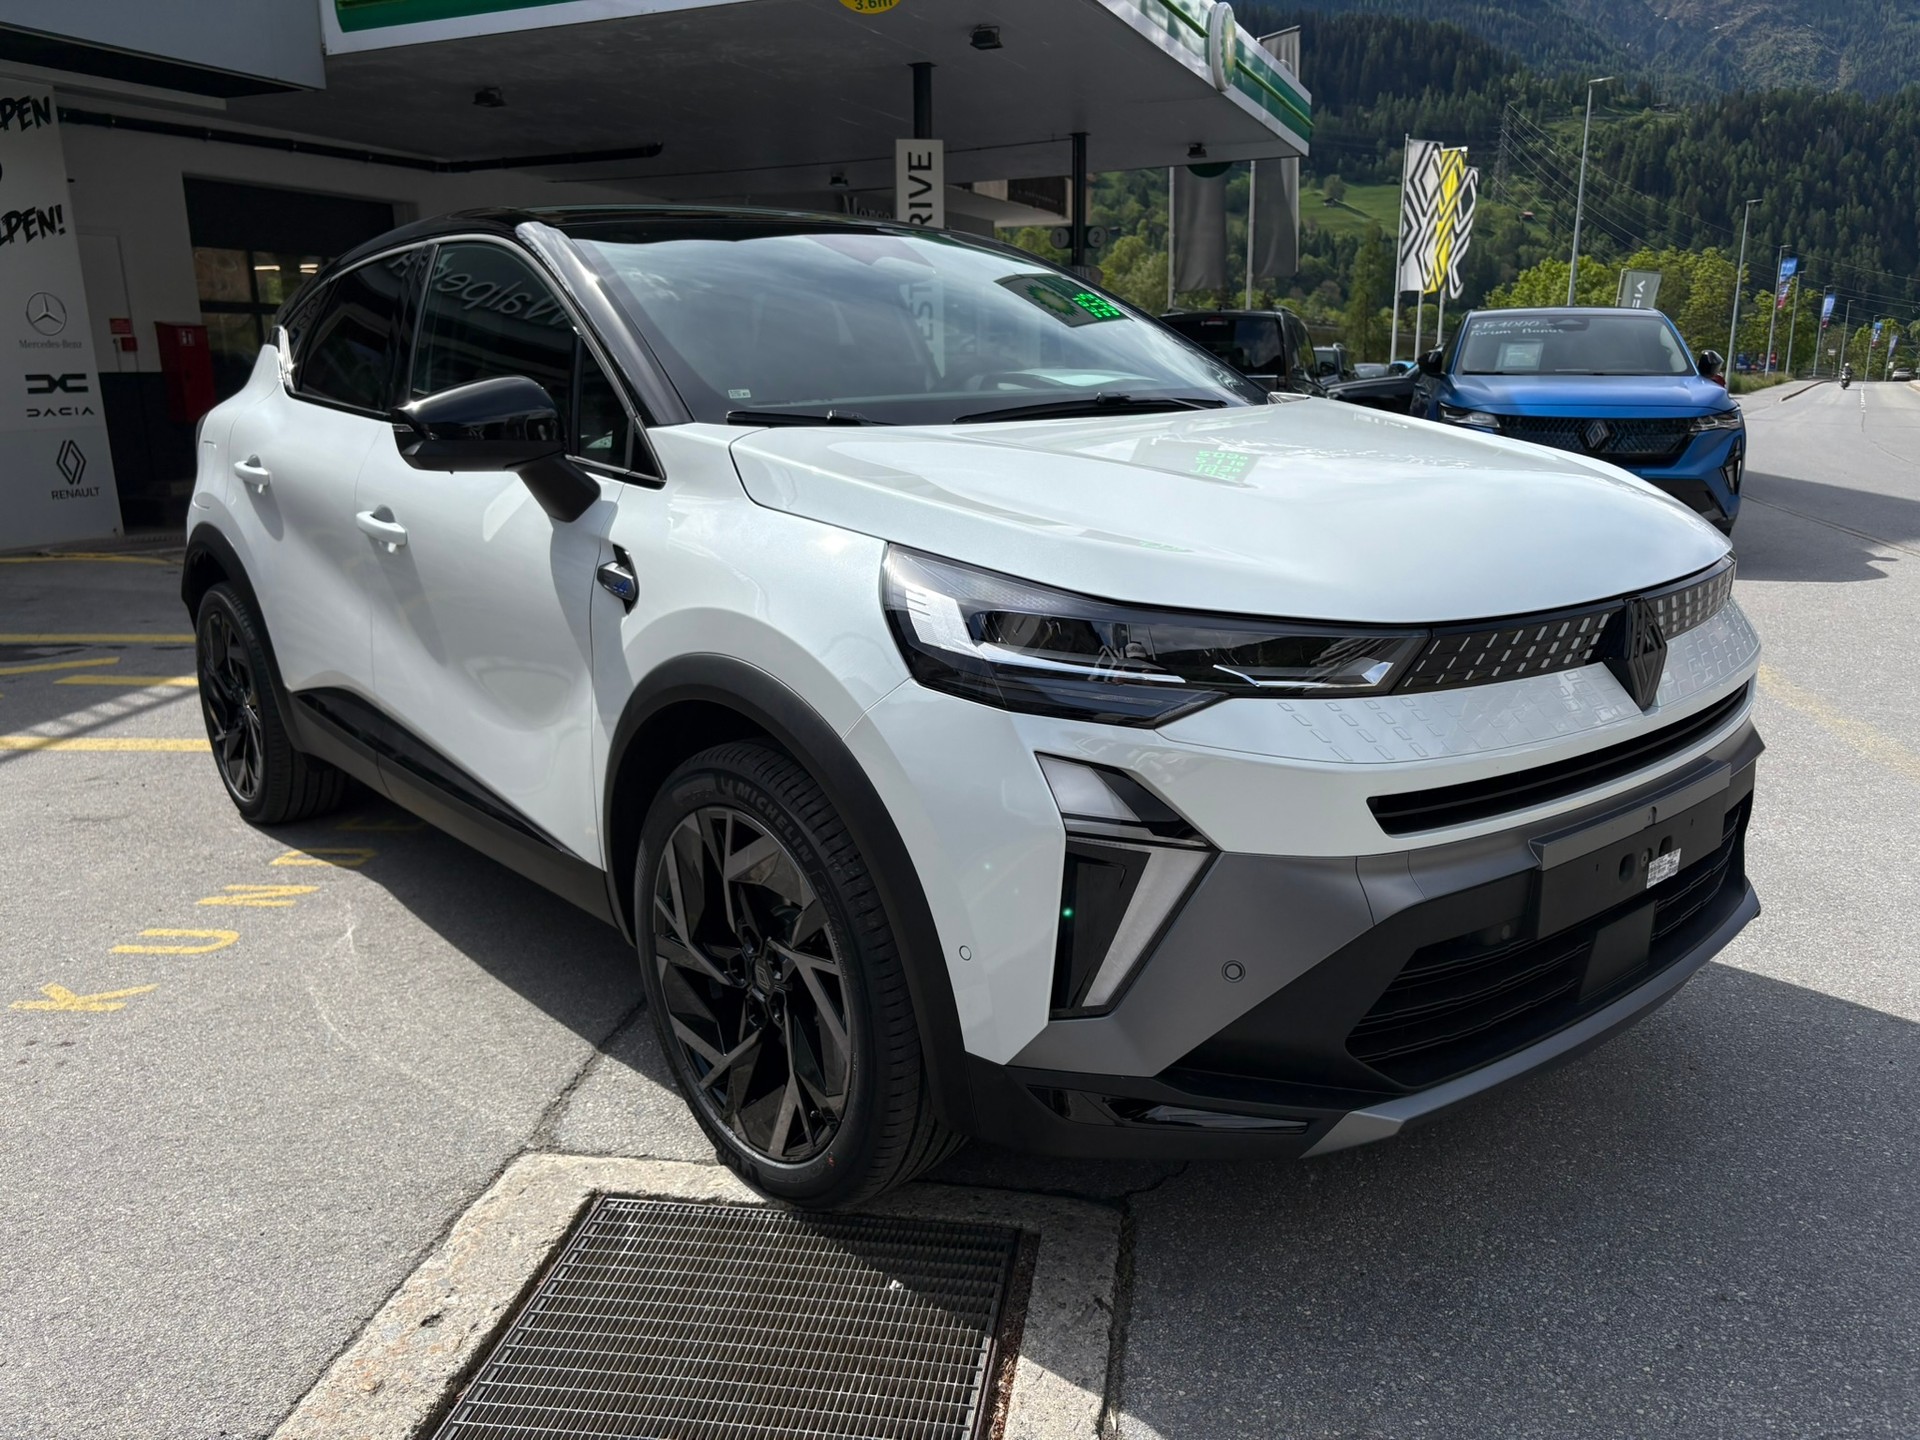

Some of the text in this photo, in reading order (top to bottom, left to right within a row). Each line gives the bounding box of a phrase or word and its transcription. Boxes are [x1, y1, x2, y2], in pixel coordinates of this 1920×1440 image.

[1093, 231, 1101, 243] 2
[18, 339, 83, 349] Mercedes-Benz
[26, 406, 95, 418] DACIA
[51, 486, 100, 500] RENAULT
[736, 780, 814, 863] MICHELIN
